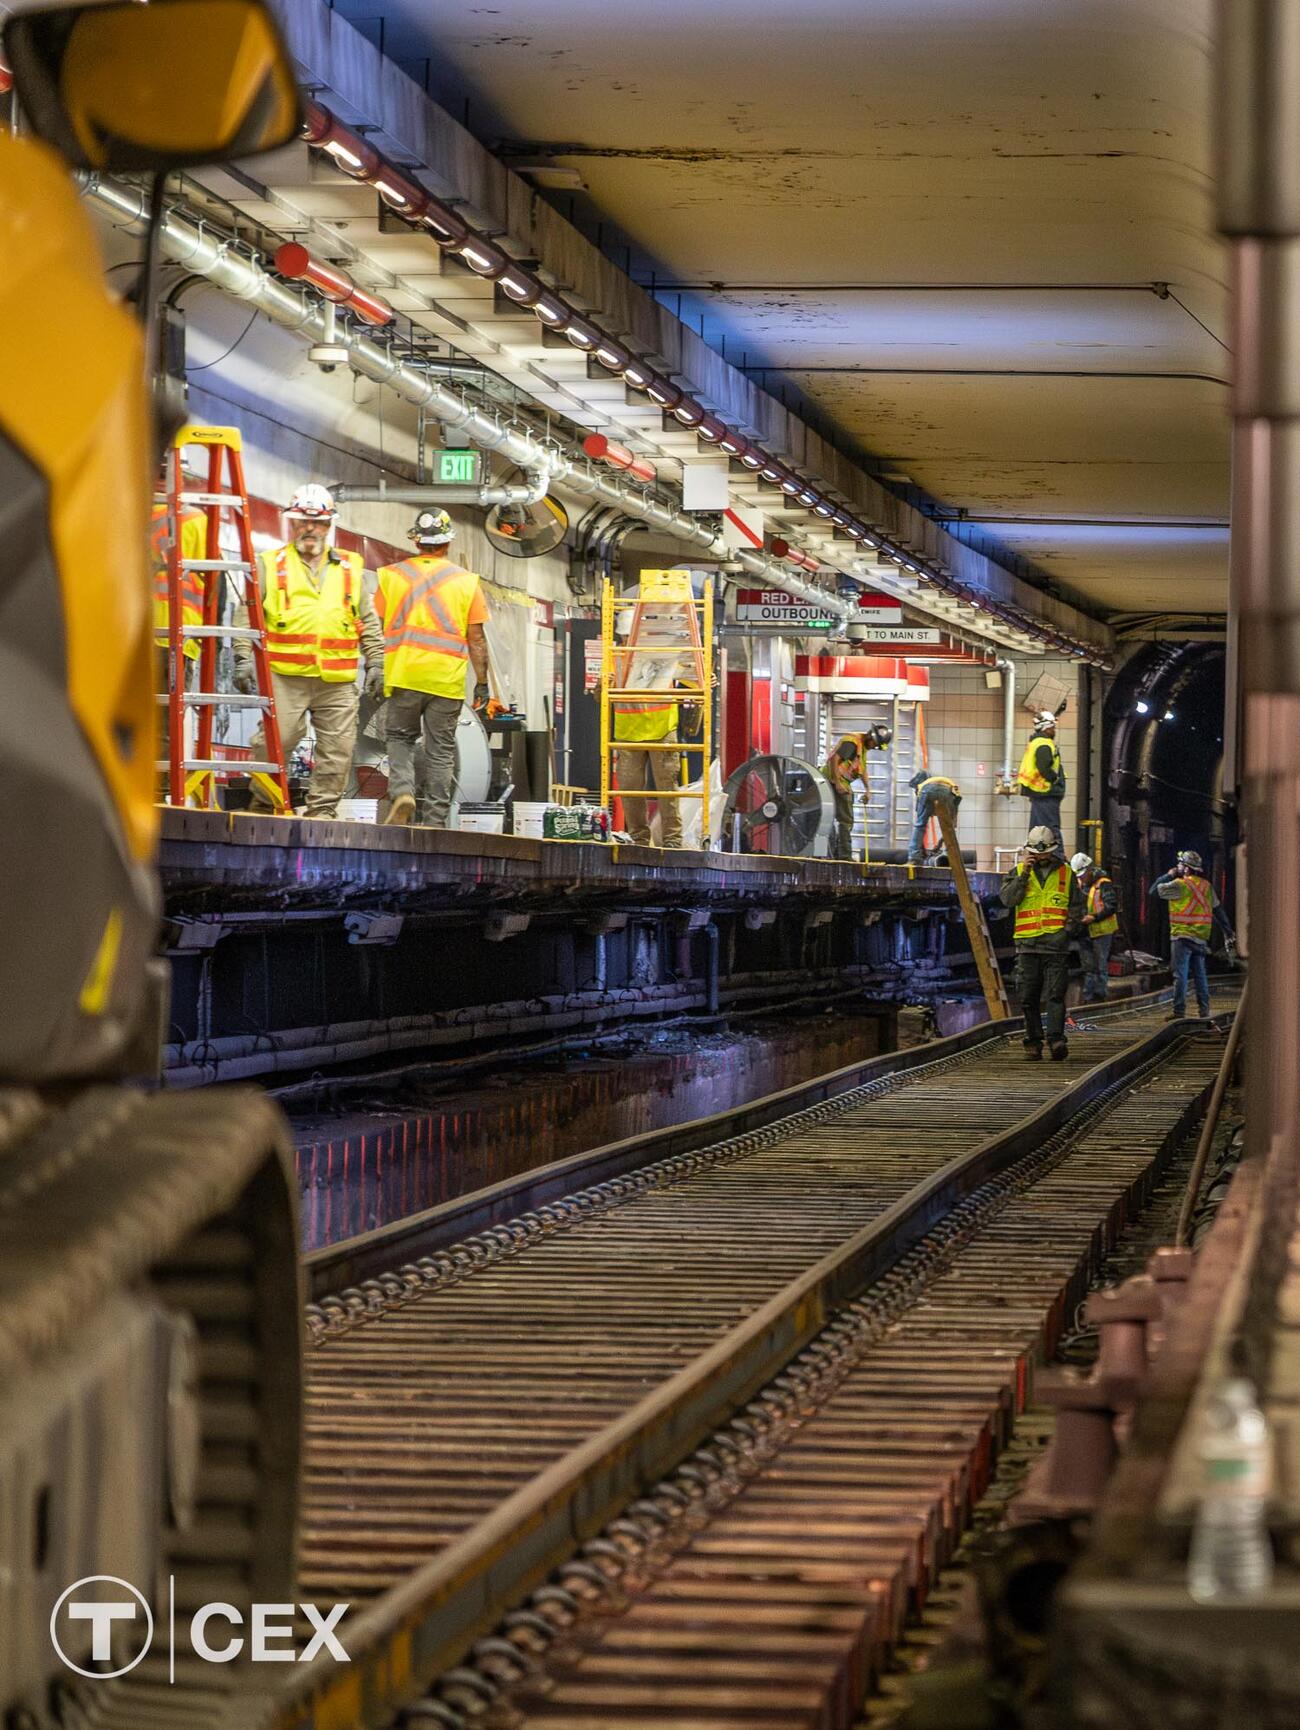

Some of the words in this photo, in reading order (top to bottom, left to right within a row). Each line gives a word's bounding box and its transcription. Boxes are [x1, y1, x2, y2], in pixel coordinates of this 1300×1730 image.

[440, 455, 475, 480] EXIT
[761, 592, 789, 604] RED
[875, 631, 887, 639] TO
[890, 631, 914, 640] MAIN
